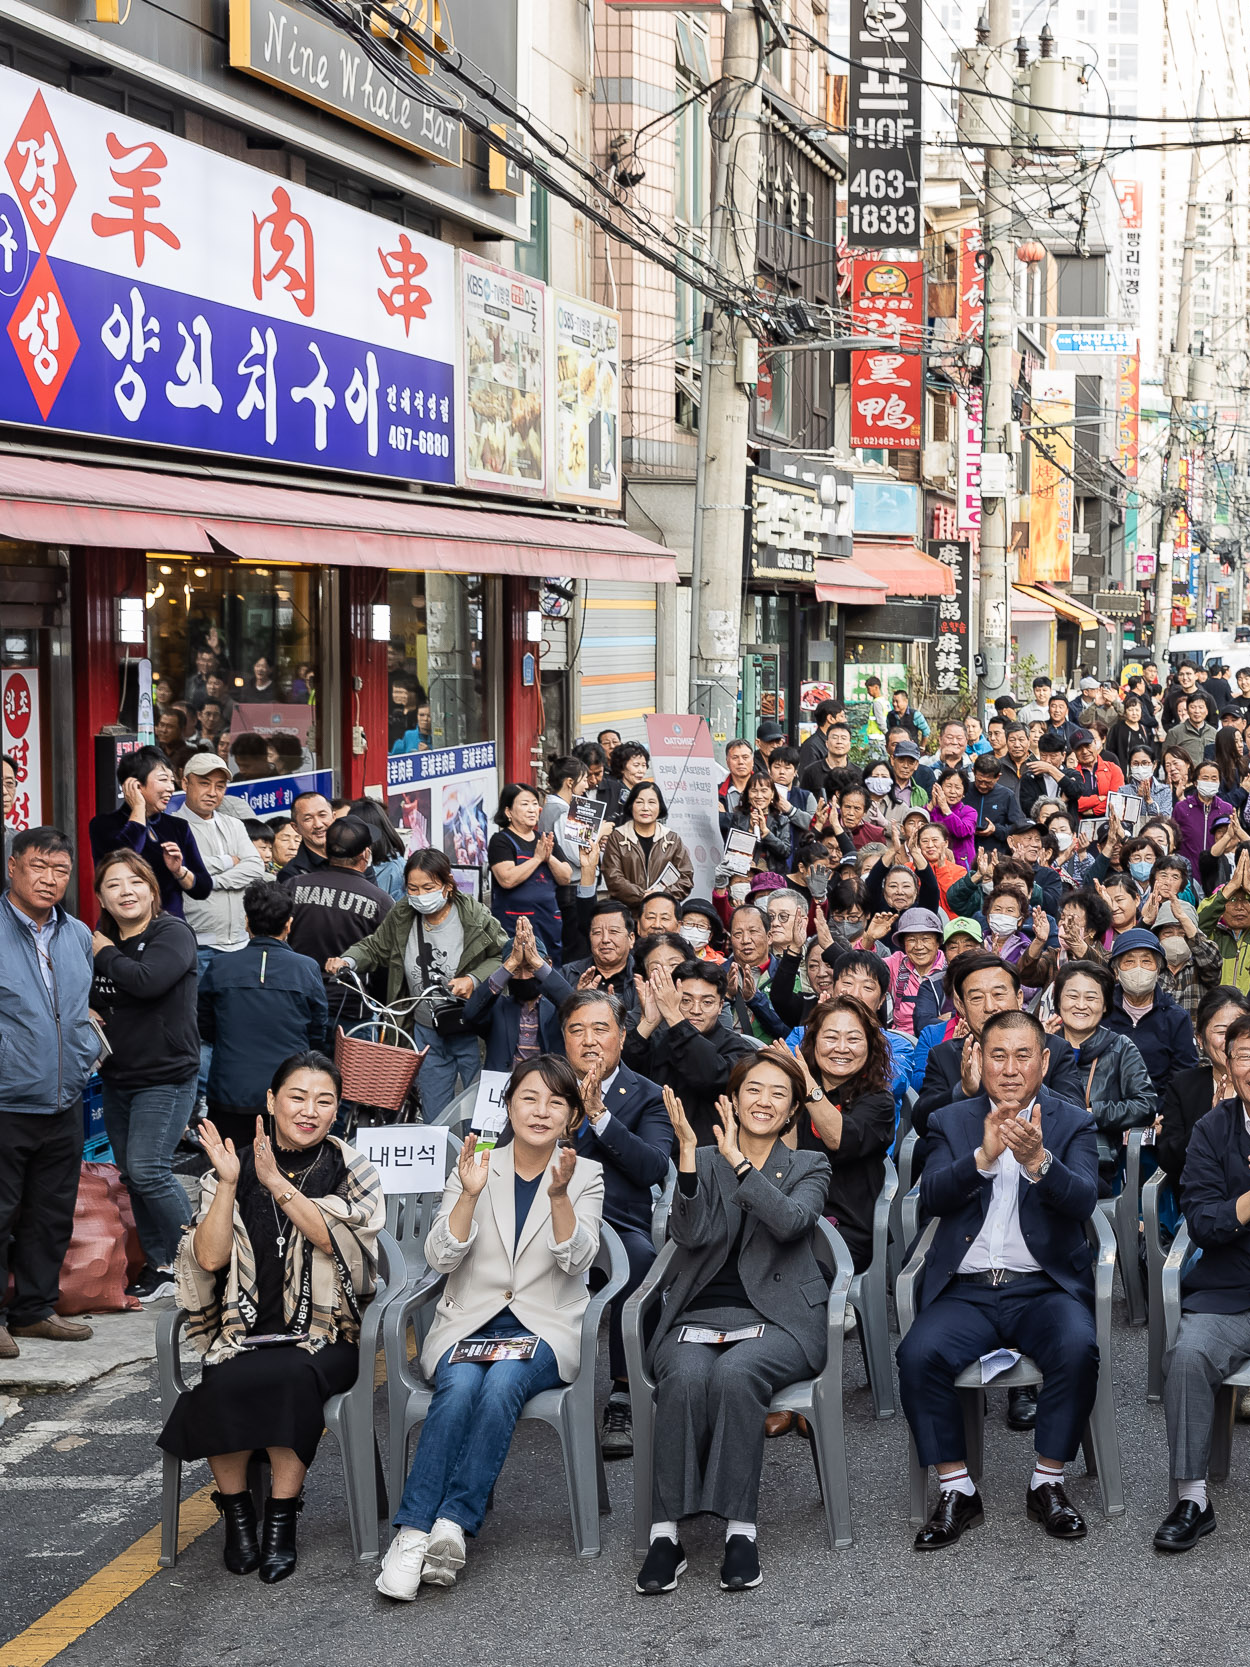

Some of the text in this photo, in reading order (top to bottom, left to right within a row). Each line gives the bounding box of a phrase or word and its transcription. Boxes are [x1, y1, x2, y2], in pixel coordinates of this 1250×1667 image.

[264, 11, 457, 150] Nine Whale Bar
[856, 117, 916, 150] HOF
[850, 168, 919, 199] 463-
[91, 131, 433, 339] 羊肉串
[850, 204, 916, 235] 1833
[467, 273, 483, 297] KBS
[100, 286, 381, 458] 양꼬치구이
[388, 424, 450, 458] 467-6880
[863, 436, 921, 447] 02)462-1881
[5, 689, 30, 720] 원조
[420, 752, 456, 777] 京城羊肉串
[462, 745, 494, 769] 京城羊肉串
[294, 885, 378, 919] MAN UTD
[369, 1144, 436, 1168] 내빈석
